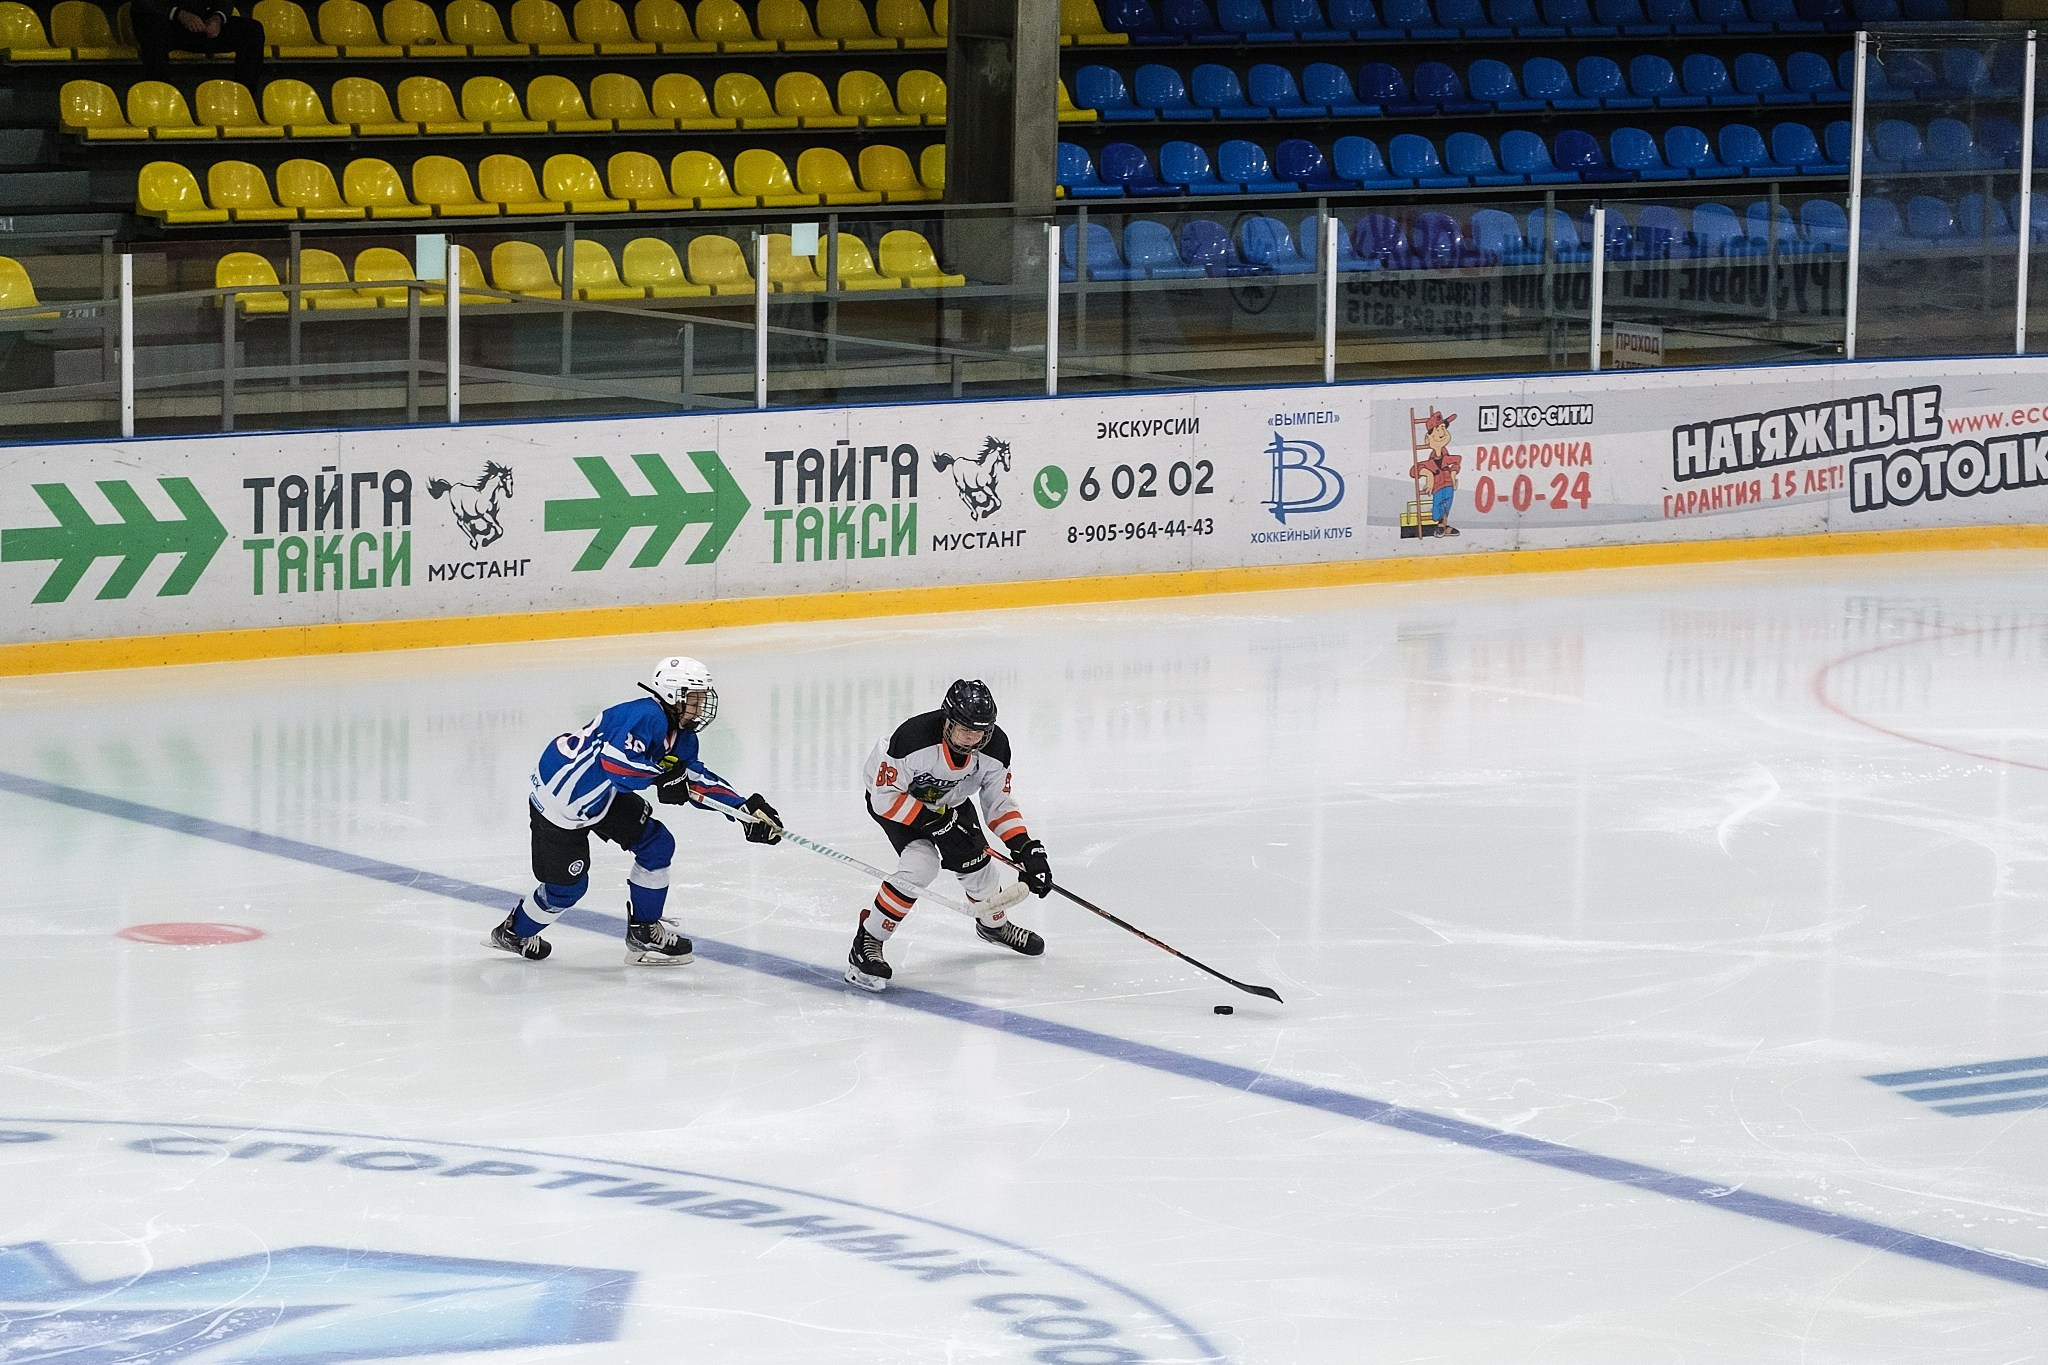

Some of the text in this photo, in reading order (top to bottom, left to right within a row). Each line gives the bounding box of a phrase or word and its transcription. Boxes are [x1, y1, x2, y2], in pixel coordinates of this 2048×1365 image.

[1616, 332, 1660, 355] ПРОХОД
[1097, 417, 1200, 440] ЭКСКУРСИИ
[1267, 411, 1341, 428] «ВЫМПЕЛ»
[1502, 404, 1594, 428] ЭКО-СИТИ
[1673, 385, 1943, 482] НАТЯЖНЫЕ
[1475, 442, 1593, 471] РАССРОЧКА
[764, 440, 919, 505] ТАЙГА
[1079, 466, 1101, 502] 6
[243, 466, 413, 534] ТАЙГА
[1474, 471, 1593, 514] 0-0-24
[1663, 464, 1844, 519] ГАРАНТИЯ 15 ЛЕТ!
[763, 502, 918, 563] ТАКСИ
[932, 529, 1027, 552] МУСТАНГ
[1067, 517, 1214, 545] 8-905-964-44-43
[1250, 526, 1353, 545] ХОККЕЙНЫЙ КЛУБ
[243, 531, 411, 596] ТАКСИ
[428, 558, 531, 582] МУСТАНГ
[875, 761, 898, 787] 82
[123, 1135, 1019, 1282] СПОРТИВНЫХ
